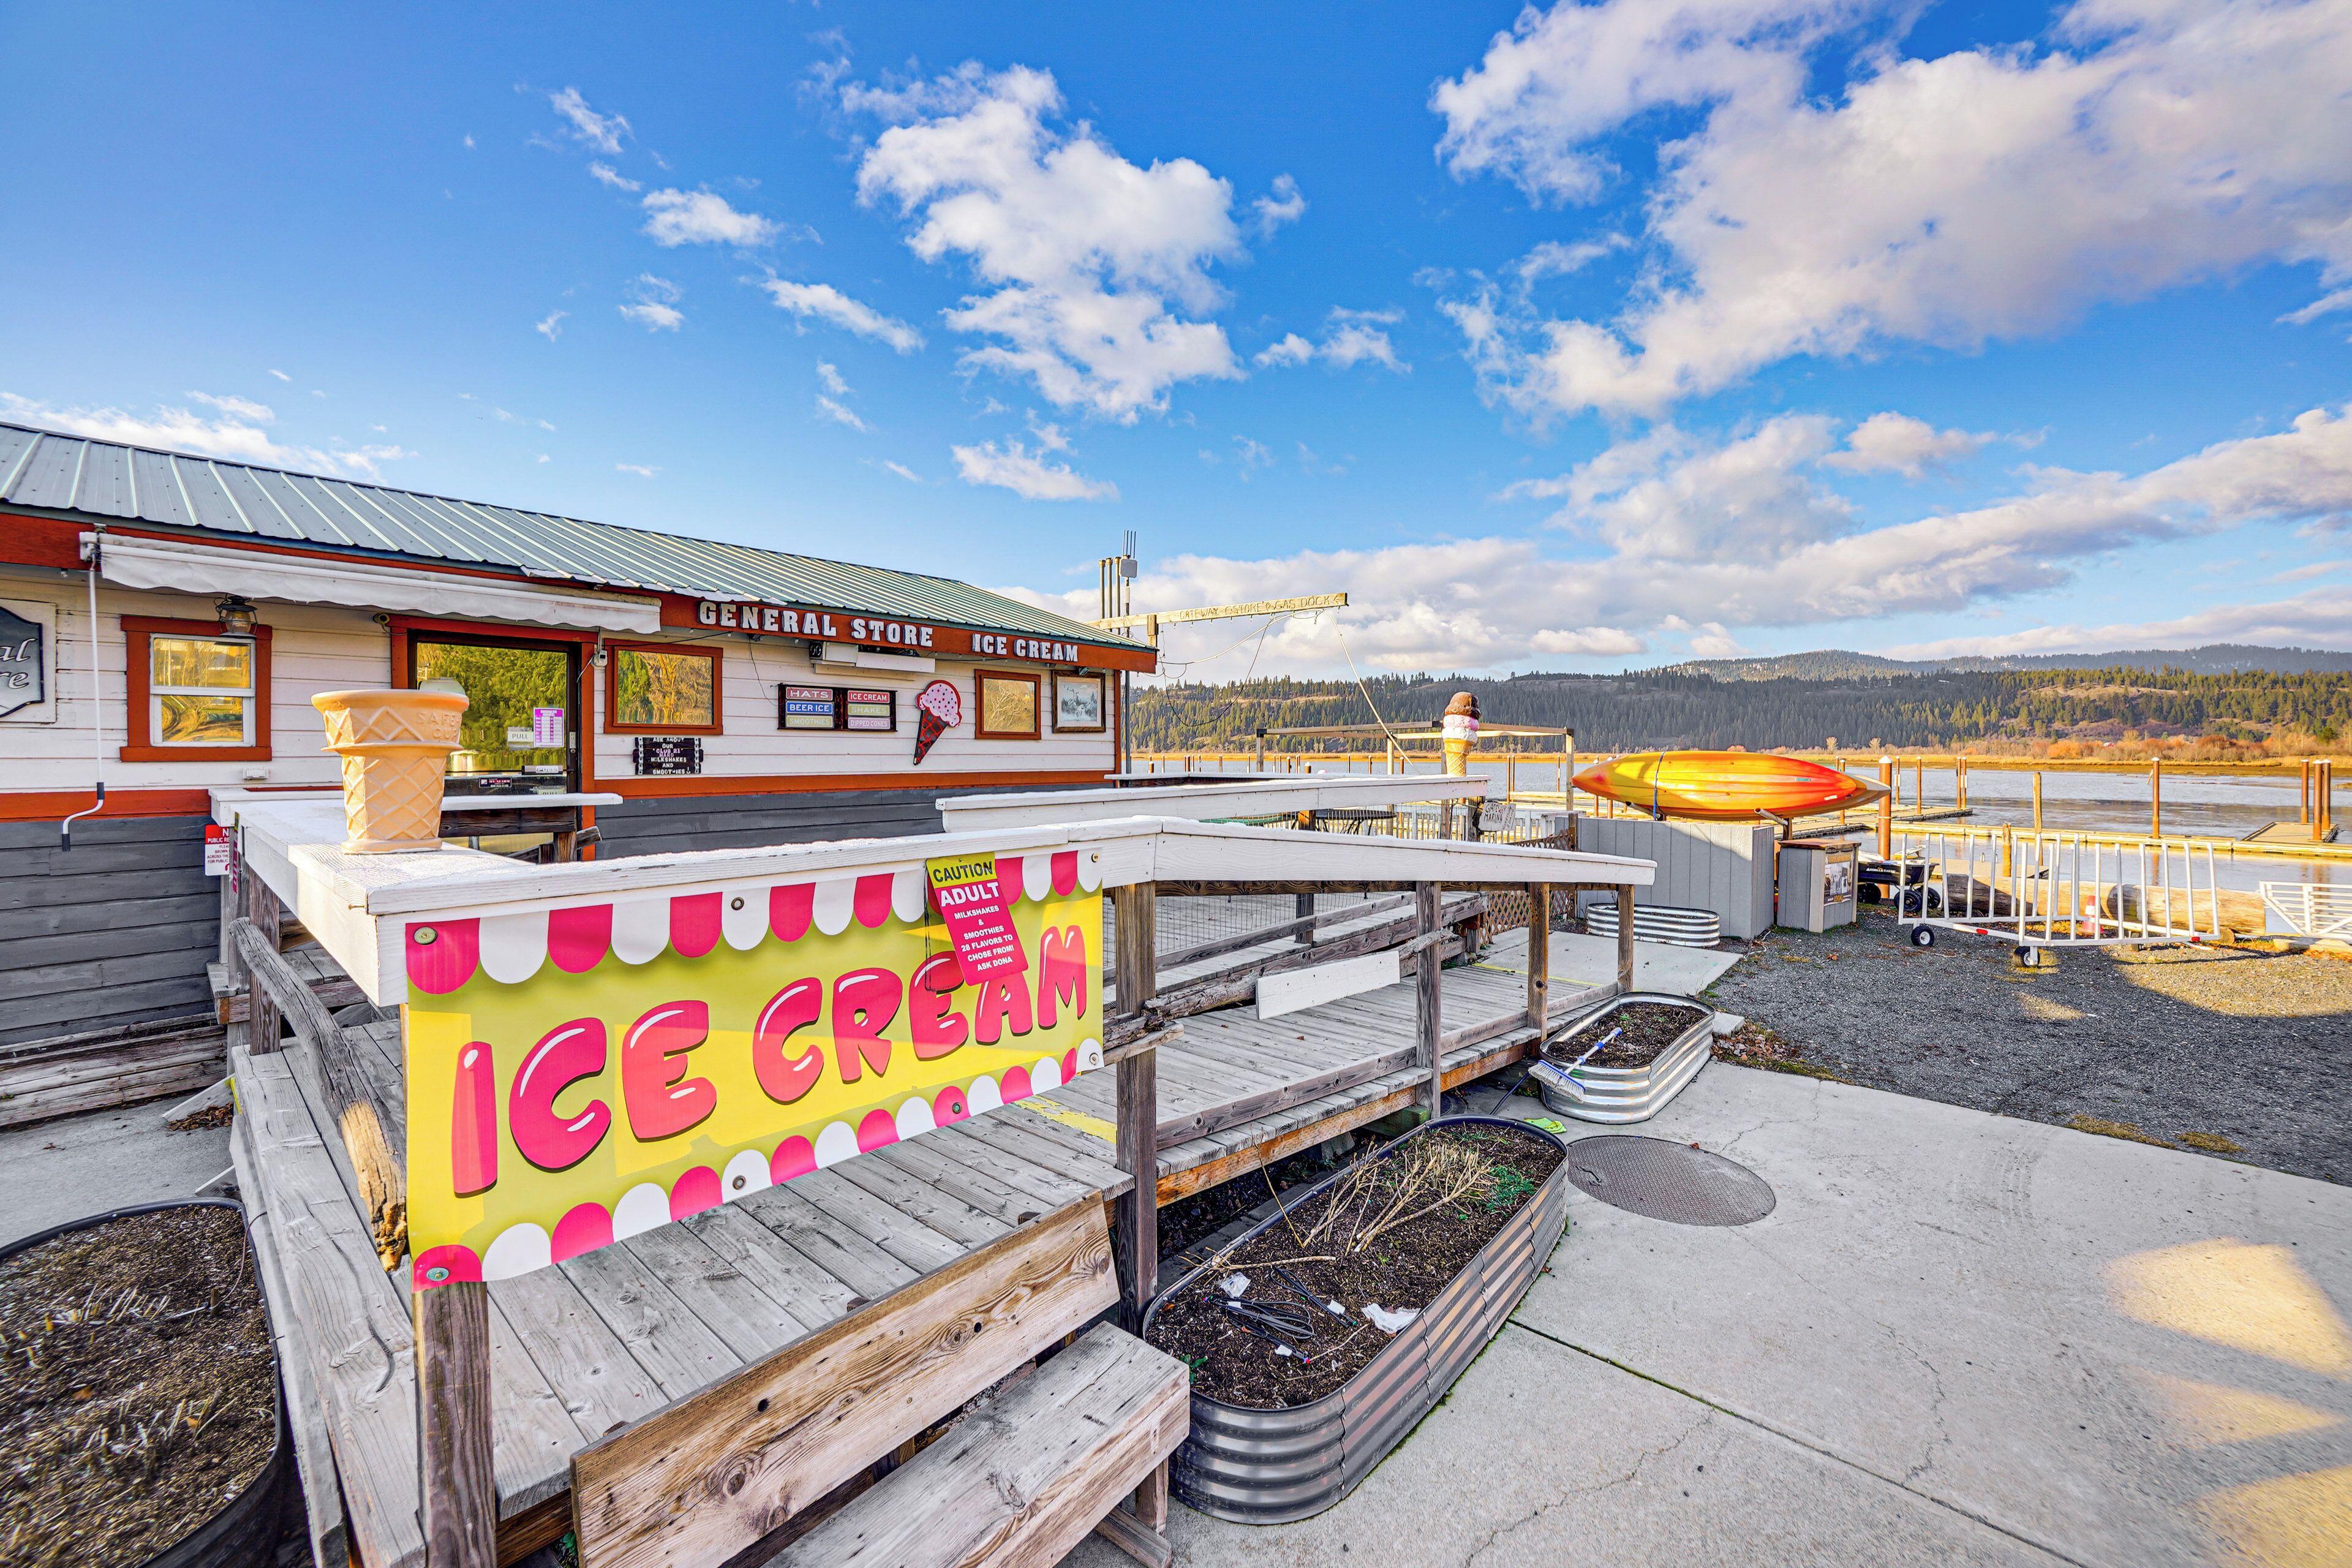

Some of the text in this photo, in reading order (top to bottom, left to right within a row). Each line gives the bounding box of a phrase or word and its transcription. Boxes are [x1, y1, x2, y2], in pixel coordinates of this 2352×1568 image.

[1300, 595, 1330, 608] DOCK
[698, 601, 933, 647] GENERAL STORE
[972, 633, 1079, 662] ICE CREAM
[1483, 813, 1503, 823] MARINA
[932, 861, 993, 883] CAUTION
[940, 881, 1000, 907] ADULT
[954, 905, 1000, 919] MILKSHAKES
[963, 925, 1005, 940] SMOOTHIES
[972, 937, 1003, 949] FLAVORS
[967, 944, 1015, 962] CHOSE FROM!
[977, 956, 1012, 971] ASK DONA
[452, 924, 1087, 1199] ICE CREAM
